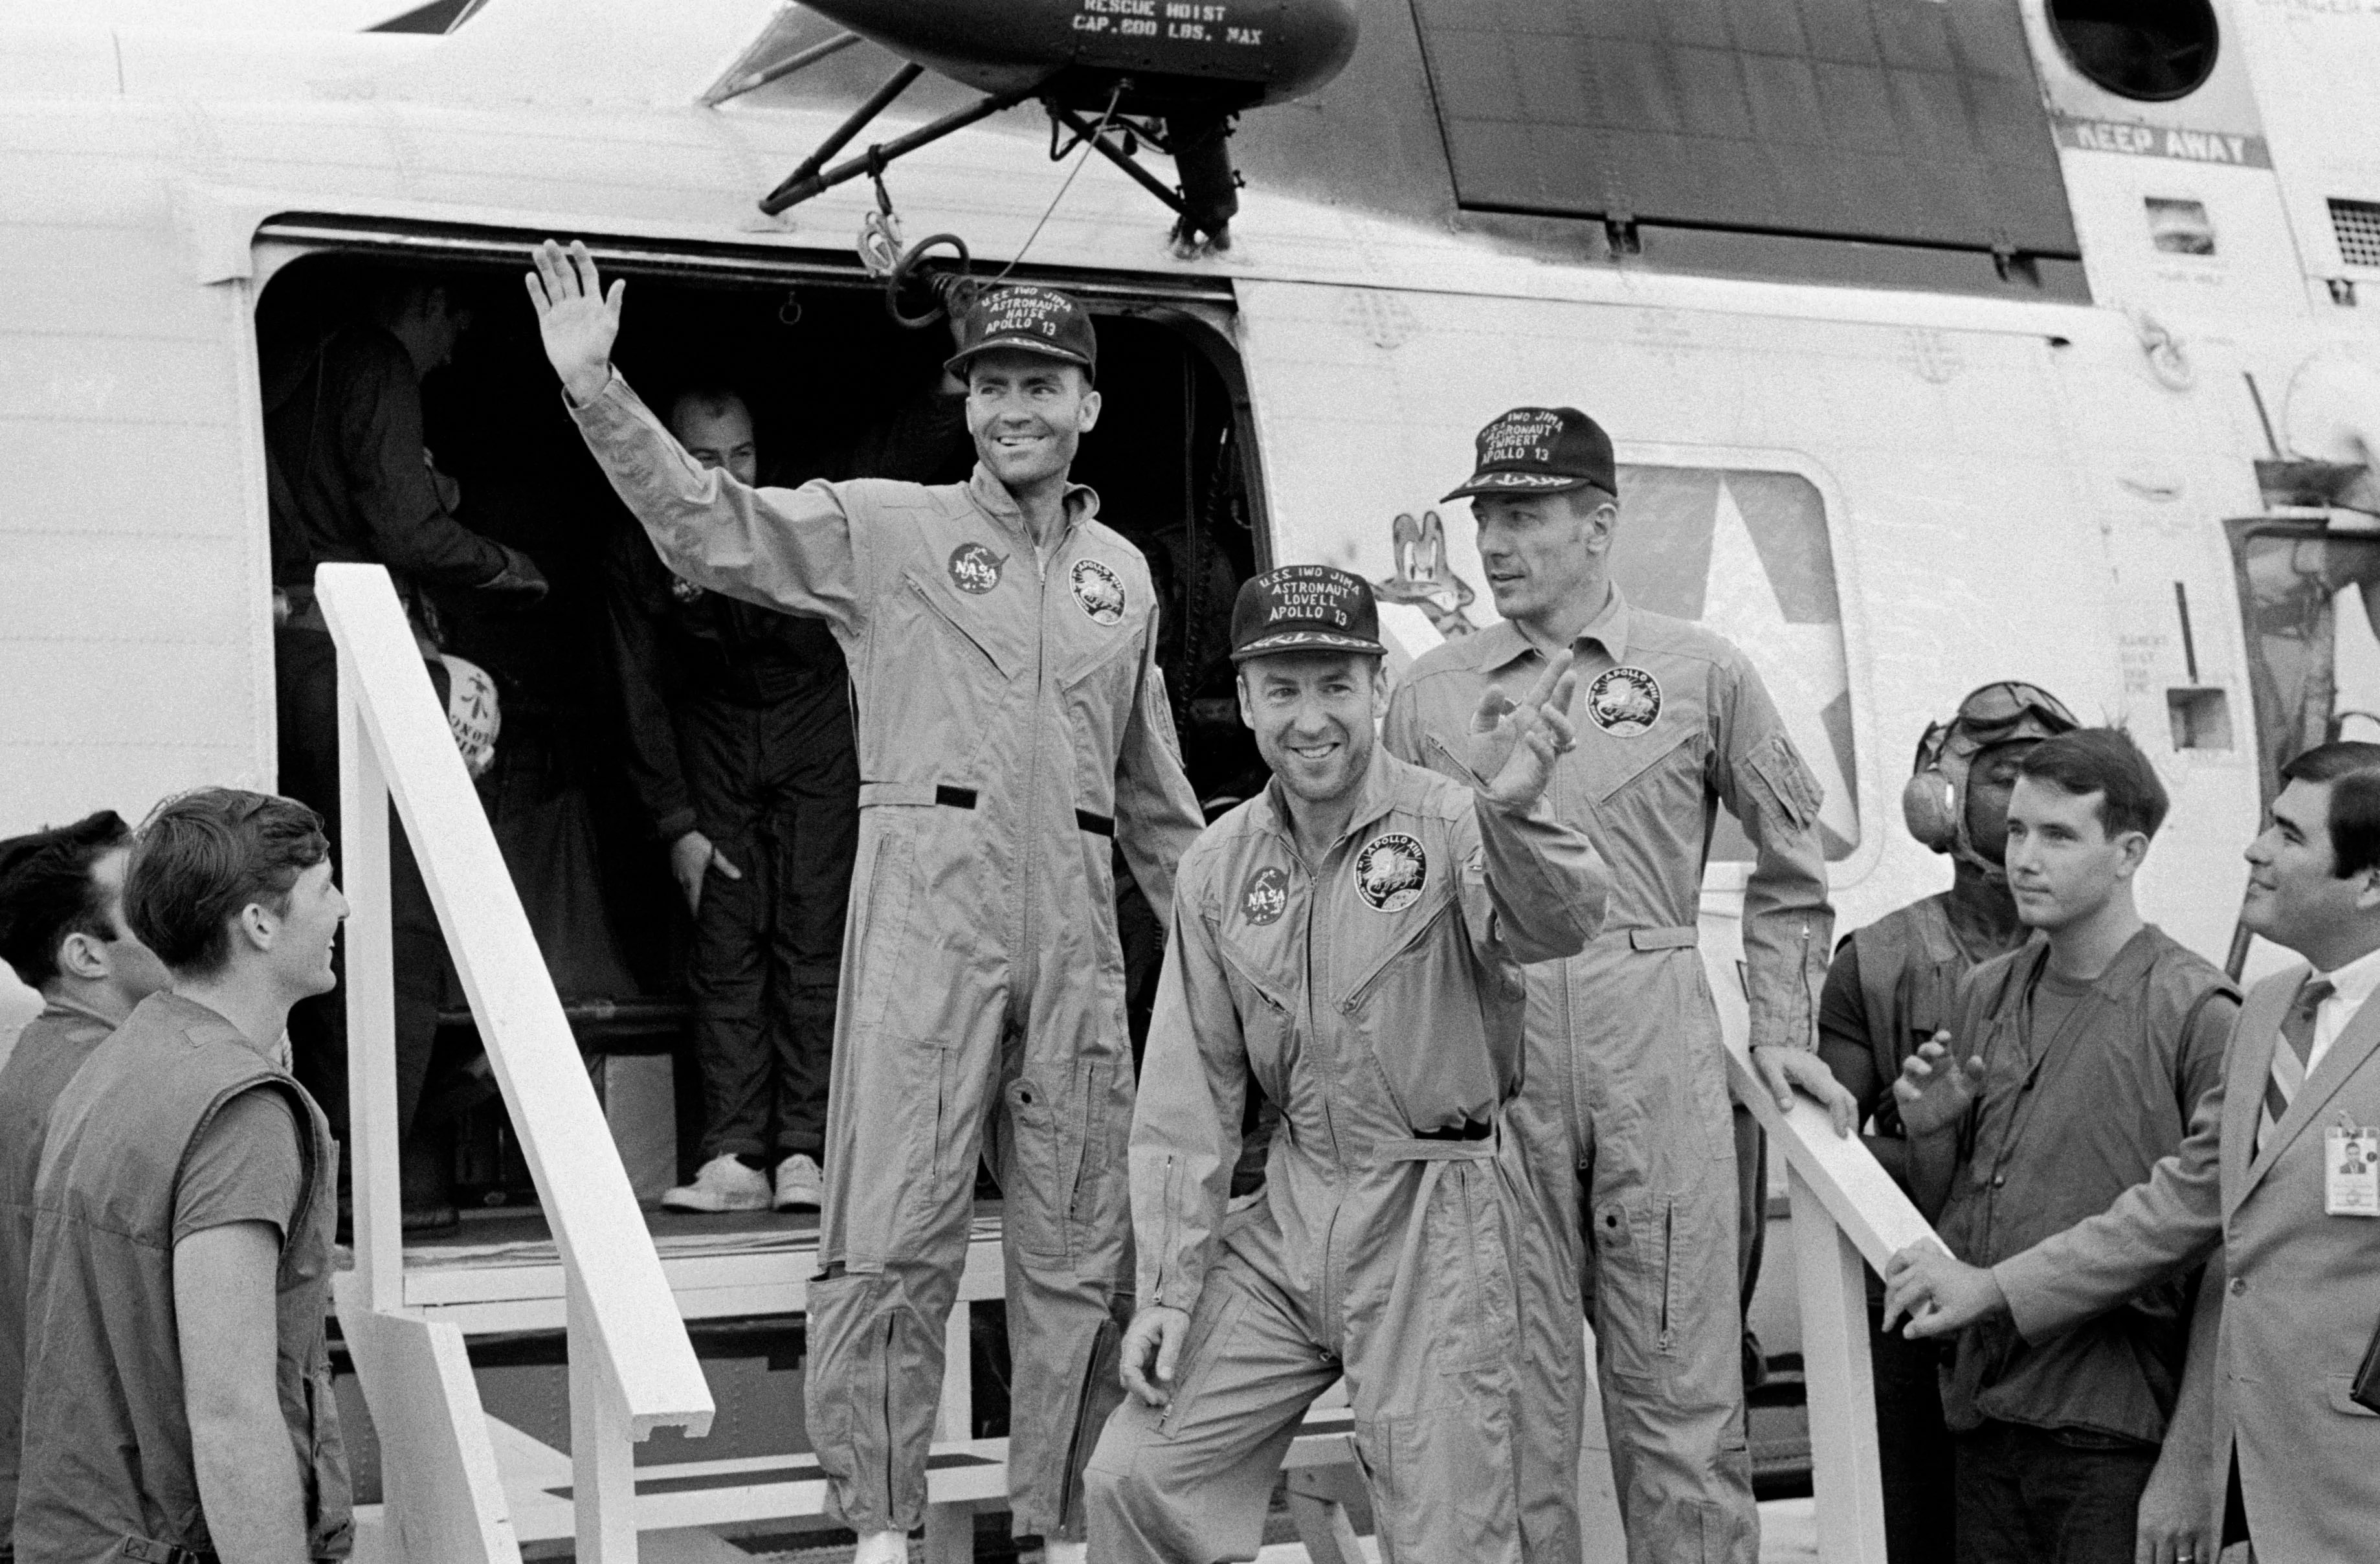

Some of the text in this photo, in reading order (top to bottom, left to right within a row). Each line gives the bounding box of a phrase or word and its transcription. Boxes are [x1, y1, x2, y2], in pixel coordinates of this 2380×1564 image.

[1084, 0, 1226, 21] RESCUE HOIST
[1227, 27, 1262, 44] MAX
[2076, 122, 2245, 162] KEEP AWAY
[990, 298, 1060, 312] ASTRONAUT
[1043, 292, 1072, 312] JIMA
[1006, 308, 1046, 319] HAISE
[985, 318, 1056, 336] APOLLO 13
[1507, 412, 1531, 421] IWO
[1535, 412, 1564, 432] JIMA
[1489, 434, 1539, 451] SWIGERT
[1481, 447, 1549, 466] APOLLO 13
[955, 560, 997, 581] NASA
[1271, 582, 1349, 598] ASTRONAUT
[1298, 568, 1322, 577] IWO
[1330, 572, 1359, 596] JIMA
[1284, 594, 1337, 607] LOVELL
[1269, 606, 1347, 626] APOLLO 13
[1606, 669, 1647, 682] APOLLO
[1368, 836, 1422, 857] APOLLO XIII
[1248, 889, 1285, 909] NASA
